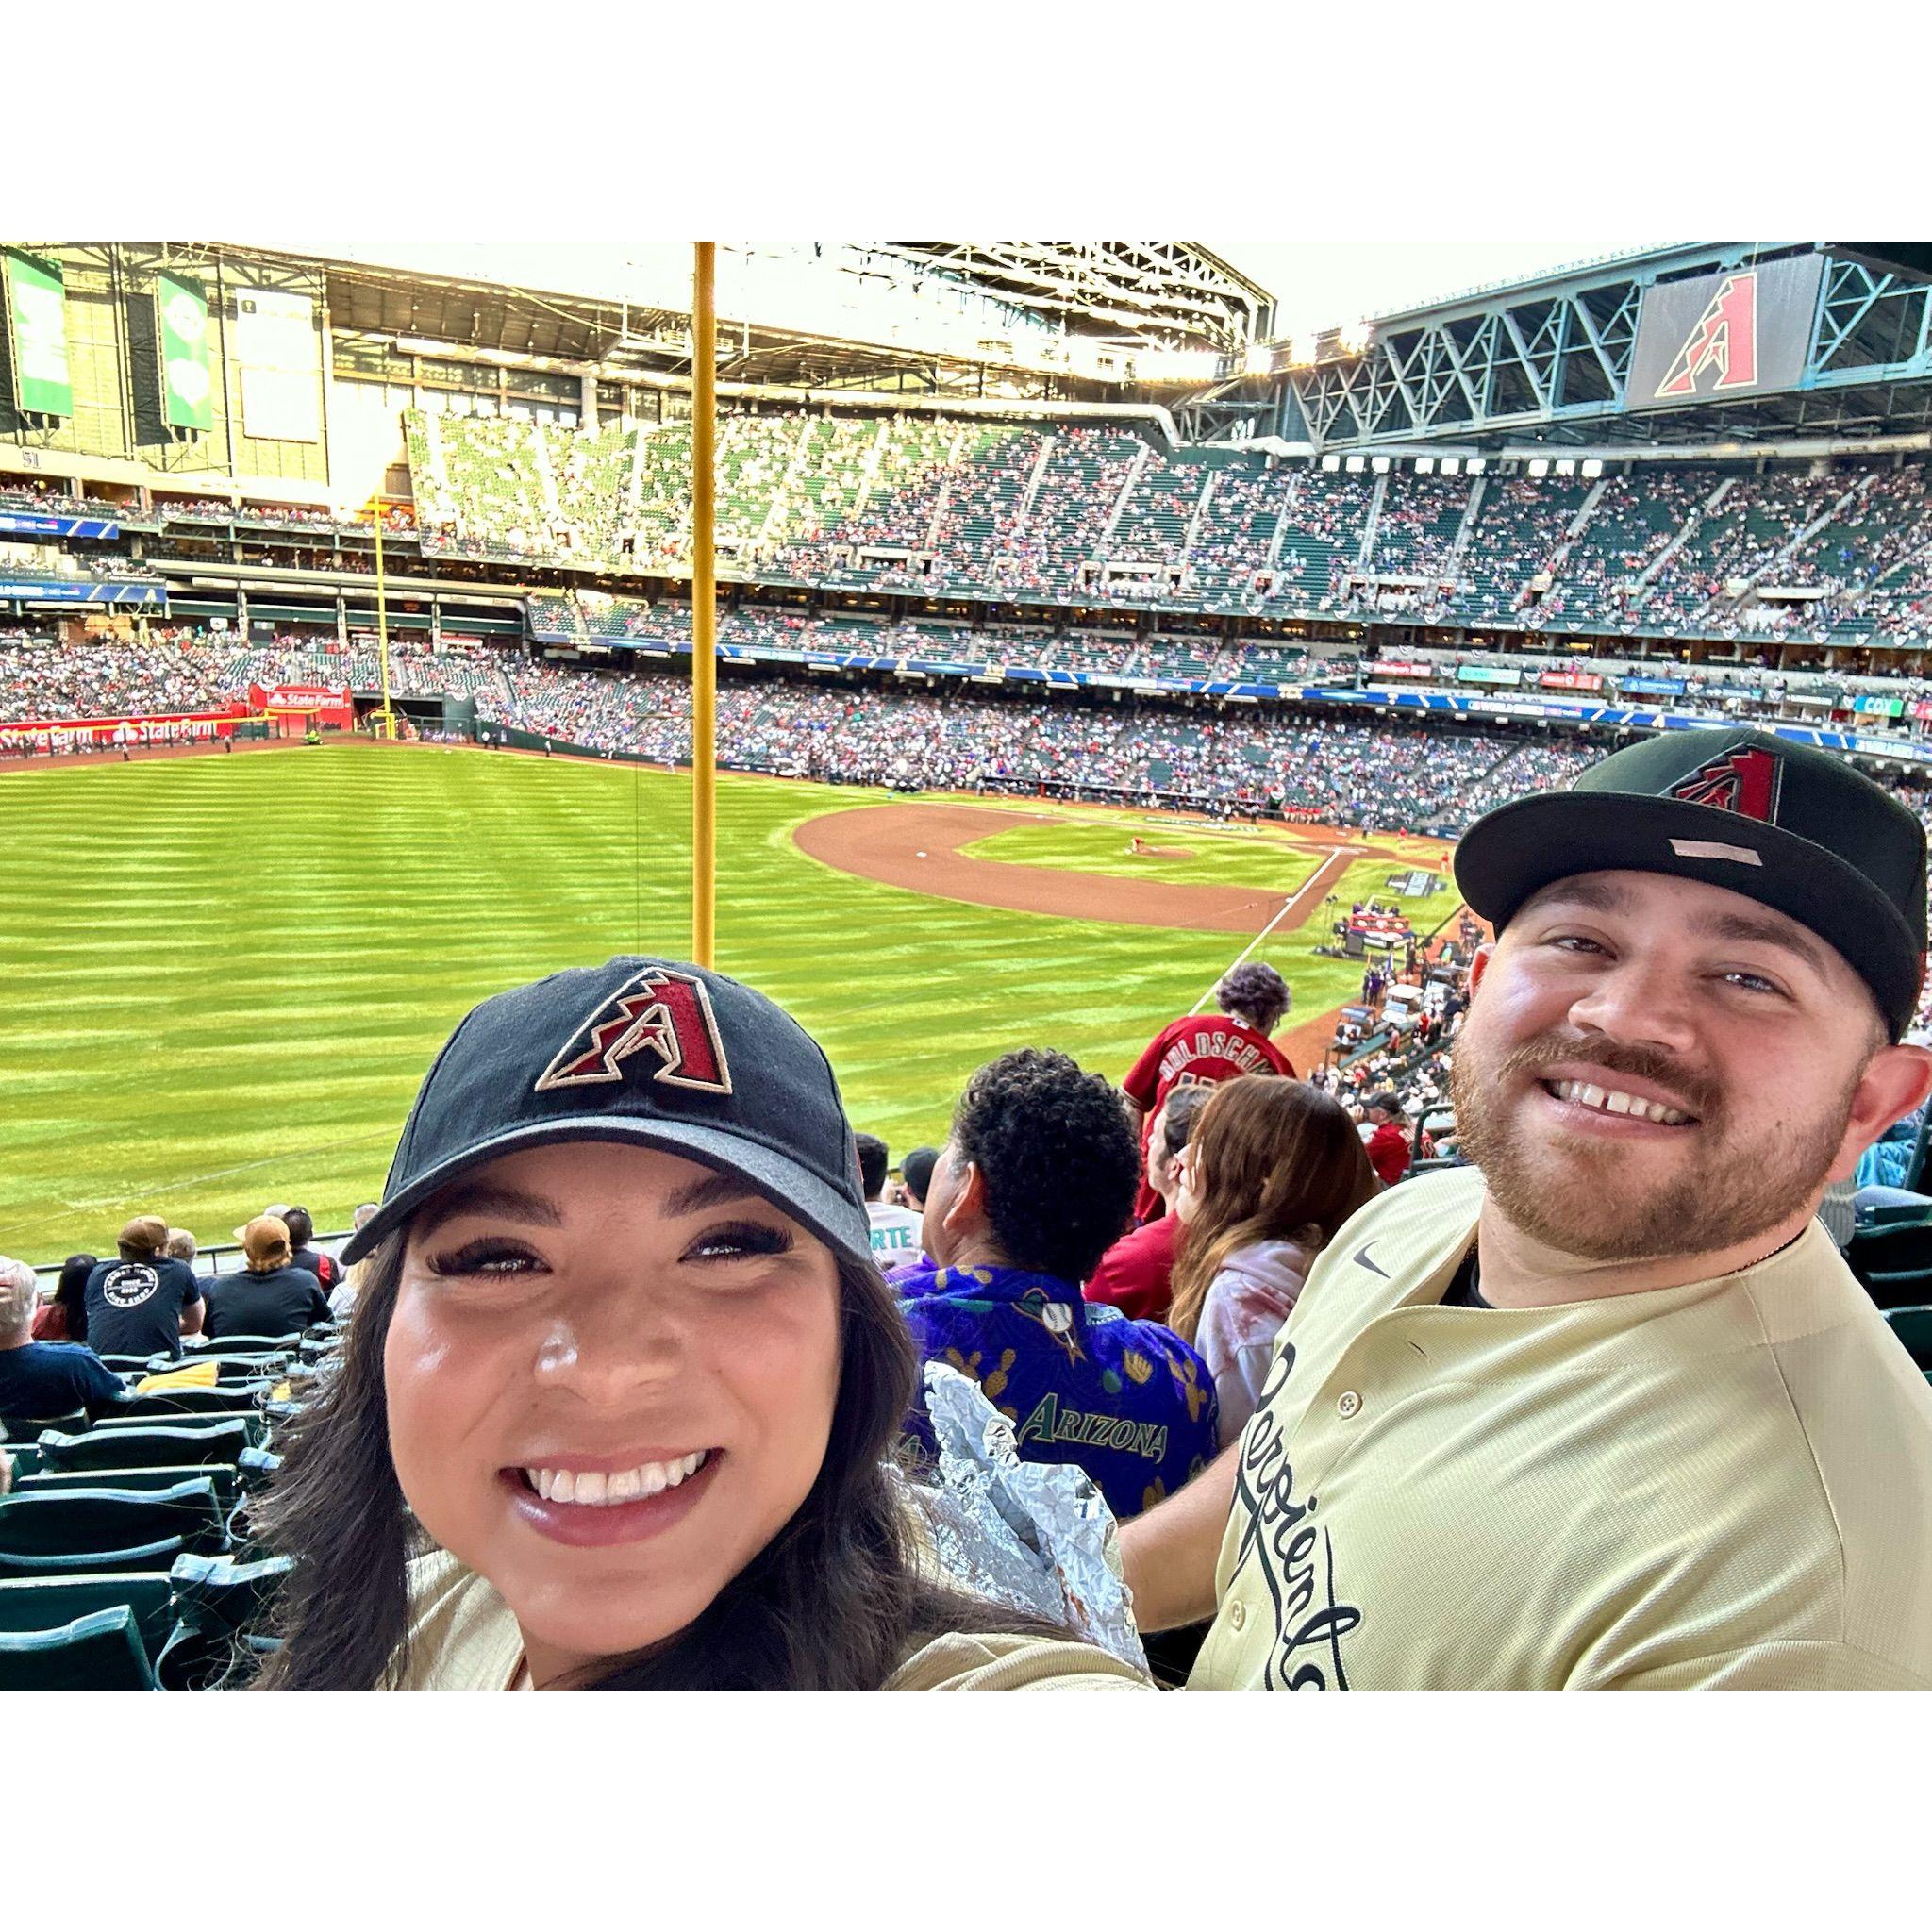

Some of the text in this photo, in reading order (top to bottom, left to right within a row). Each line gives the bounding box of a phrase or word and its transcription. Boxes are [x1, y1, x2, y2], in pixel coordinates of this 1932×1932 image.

[23, 450, 41, 469] 51
[1864, 697, 1895, 715] COX
[535, 966, 733, 1094] A
[870, 1226, 913, 1250] RTE
[1017, 1391, 1169, 1465] ARIZONA
